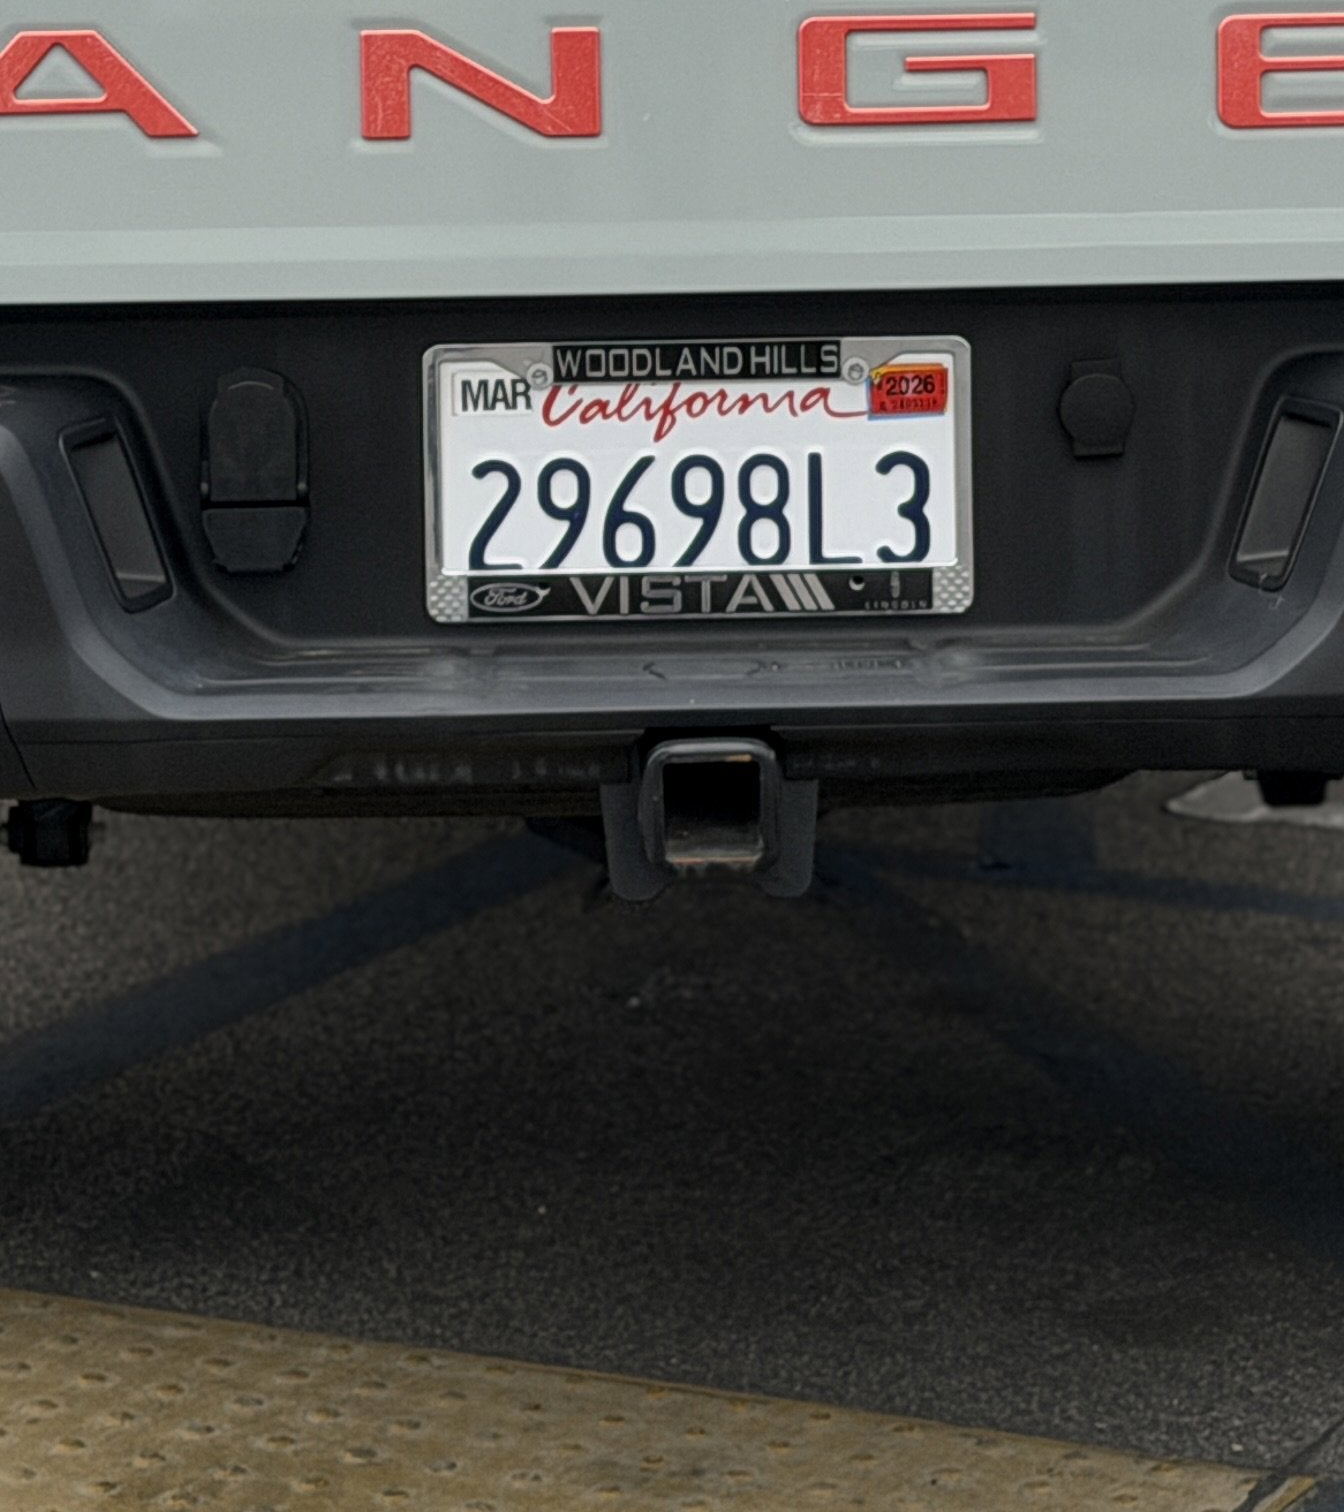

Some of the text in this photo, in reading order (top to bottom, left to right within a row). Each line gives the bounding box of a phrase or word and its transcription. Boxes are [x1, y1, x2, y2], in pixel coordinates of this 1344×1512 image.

[556, 344, 840, 378] WOODLAND HILLS
[460, 378, 532, 412] MAR
[885, 374, 936, 397] 2026
[541, 381, 869, 442] California
[468, 450, 931, 569] 29698L3
[483, 587, 529, 606] Ford
[569, 574, 775, 615] VISTA
